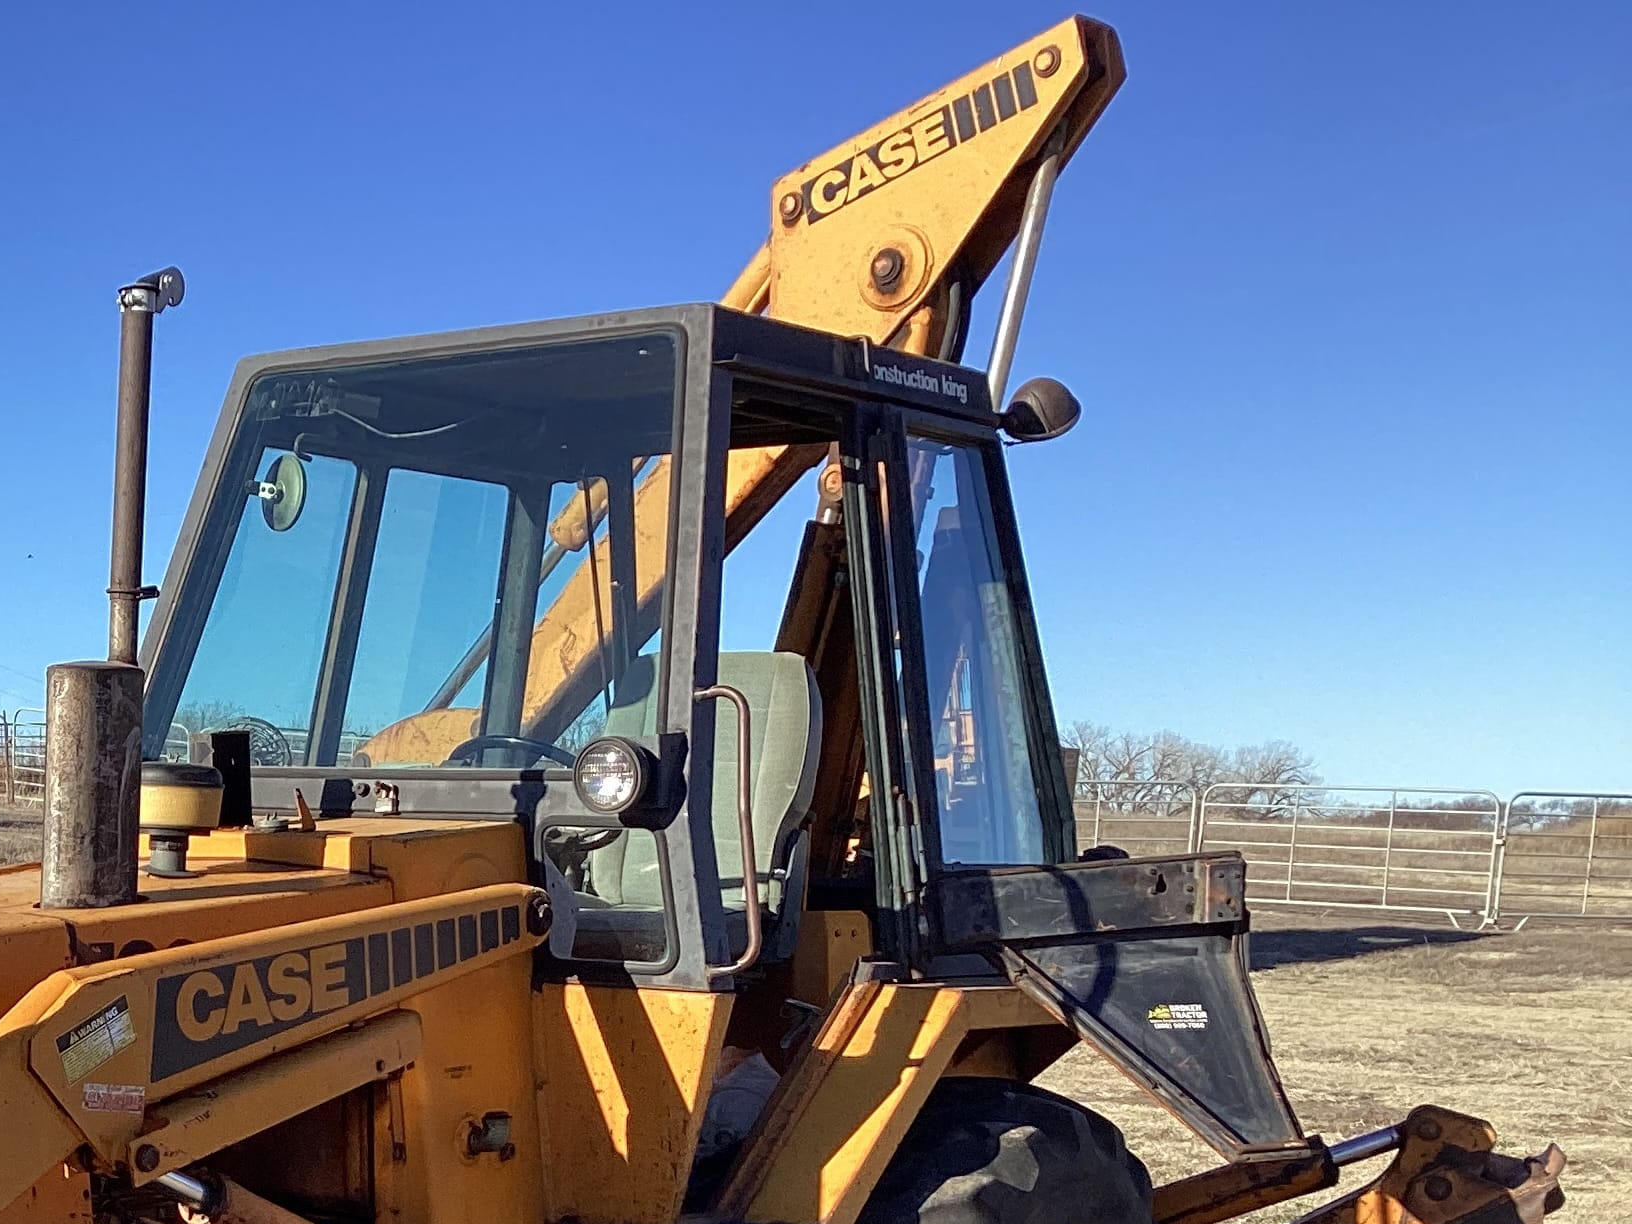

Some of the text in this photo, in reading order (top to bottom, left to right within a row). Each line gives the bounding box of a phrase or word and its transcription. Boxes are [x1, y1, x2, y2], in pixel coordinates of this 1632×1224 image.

[810, 116, 952, 216] CASE
[941, 374, 968, 404] king
[176, 942, 350, 1042] CASE
[1171, 1011, 1208, 1019] TRACTOR
